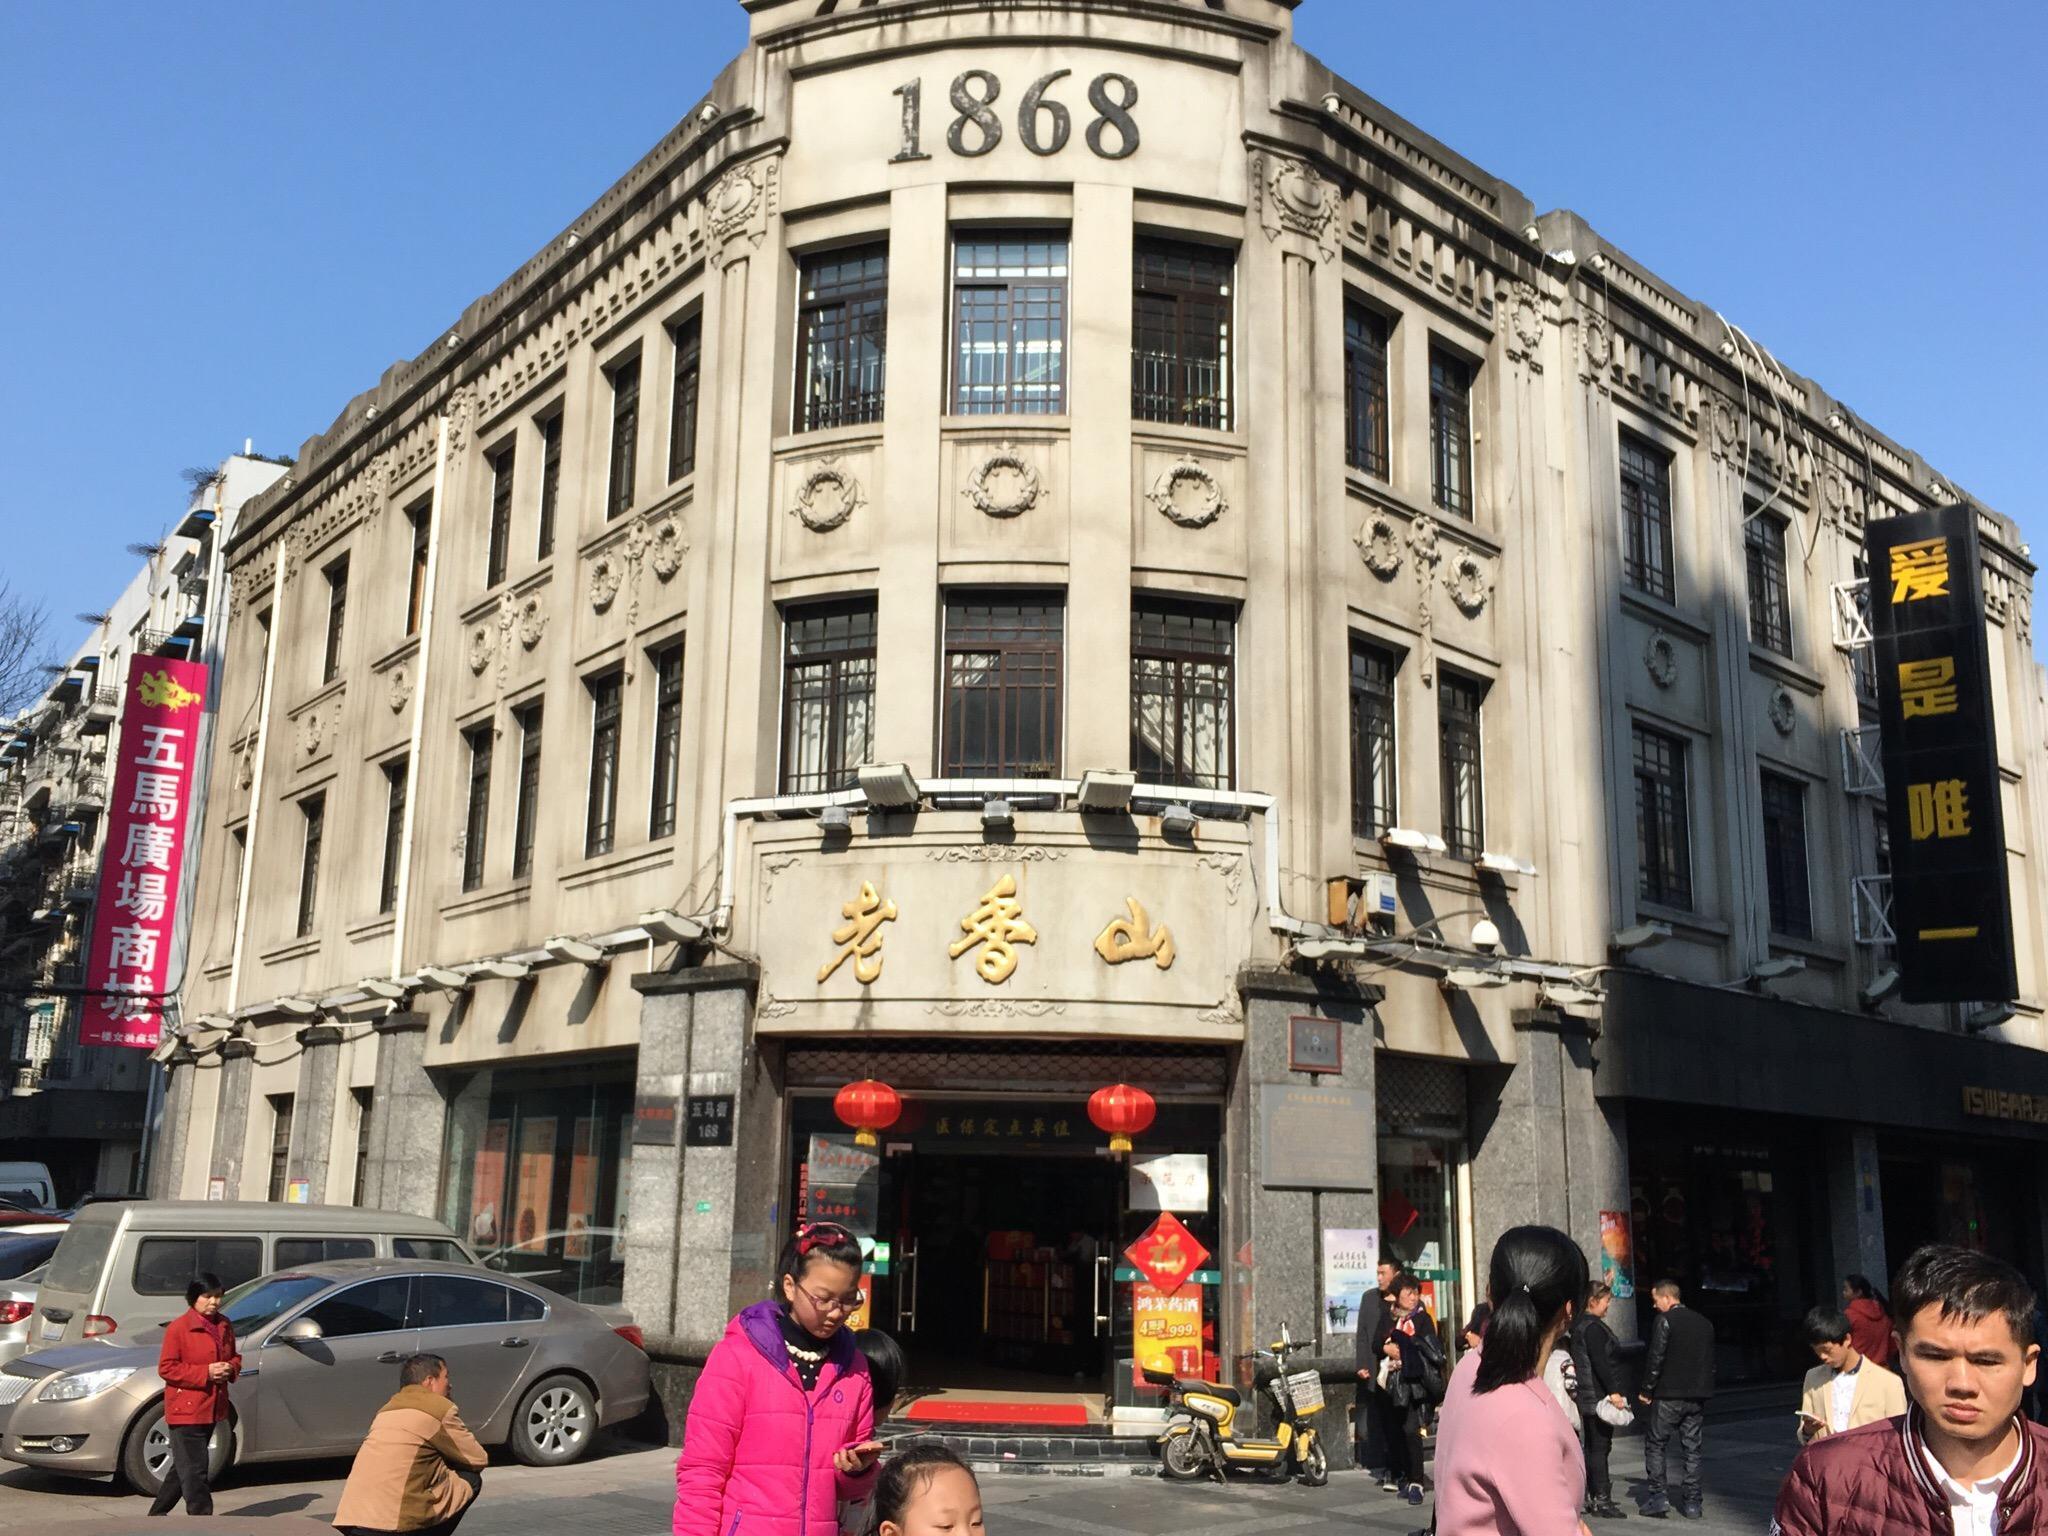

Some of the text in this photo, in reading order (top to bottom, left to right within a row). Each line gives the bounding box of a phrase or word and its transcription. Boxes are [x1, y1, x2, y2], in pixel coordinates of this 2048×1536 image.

[888, 69, 1140, 165] 1868
[1888, 537, 1979, 941] 爱是唯一
[100, 725, 185, 1024] 五馬廣場商城
[816, 873, 1177, 986] 老香山
[1136, 1295, 1199, 1313] 鸿茅药酒
[1148, 1233, 1188, 1275] 福
